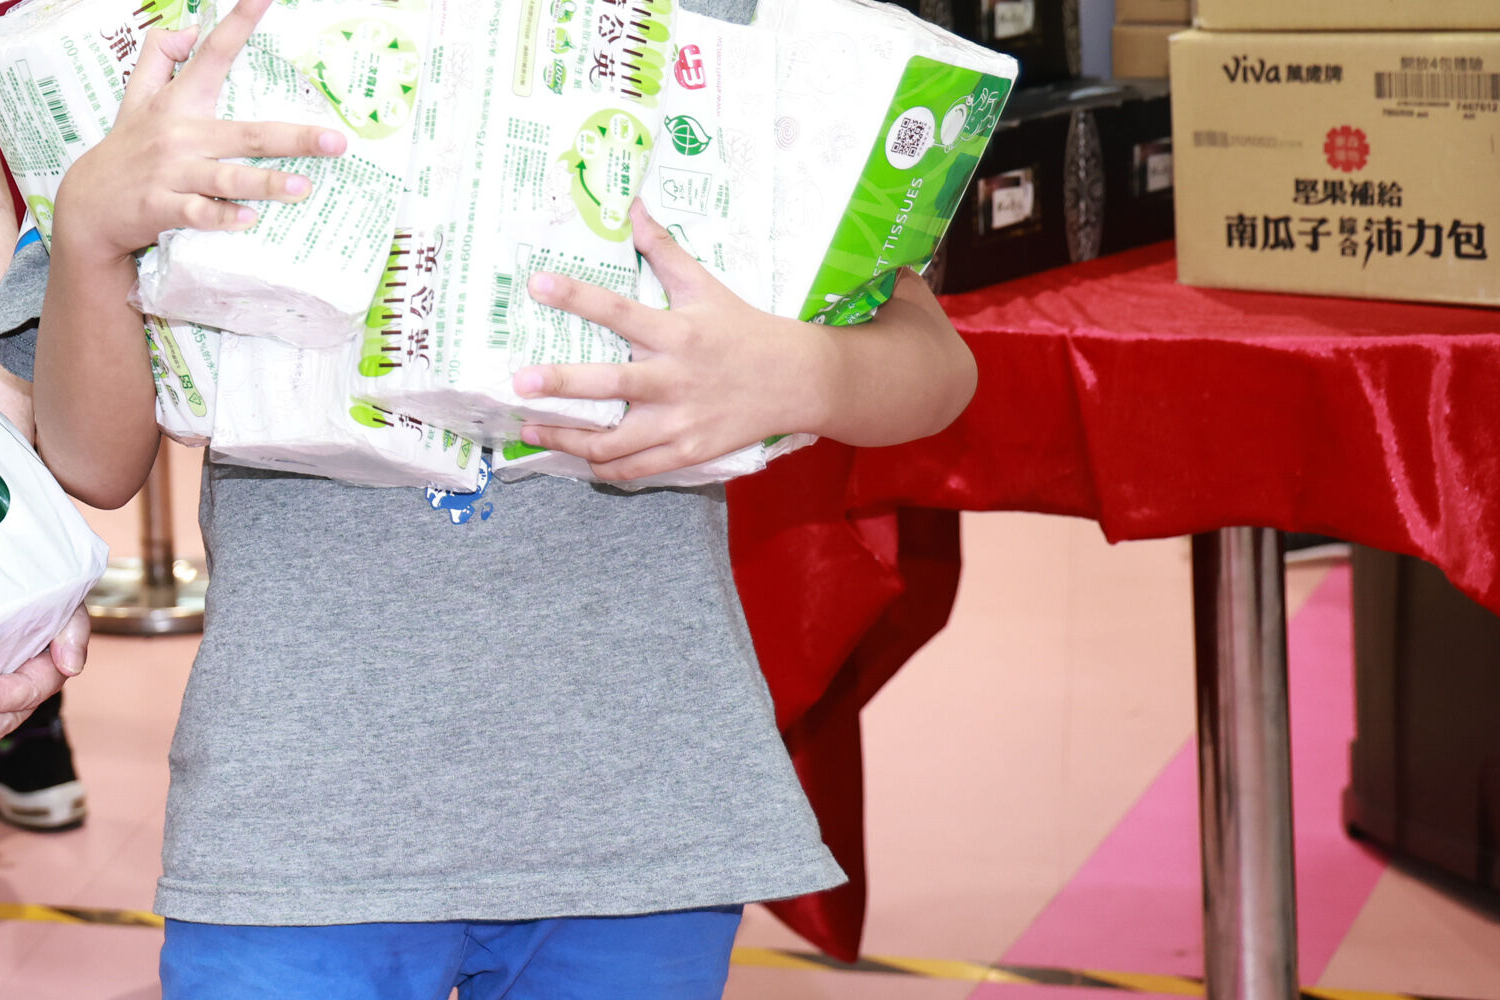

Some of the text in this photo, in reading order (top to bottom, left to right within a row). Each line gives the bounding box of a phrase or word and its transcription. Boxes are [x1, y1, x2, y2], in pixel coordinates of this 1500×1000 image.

[883, 174, 924, 250] TISSUES
[1292, 178, 1403, 208] 堅果補給
[406, 230, 444, 371] 蒲公英
